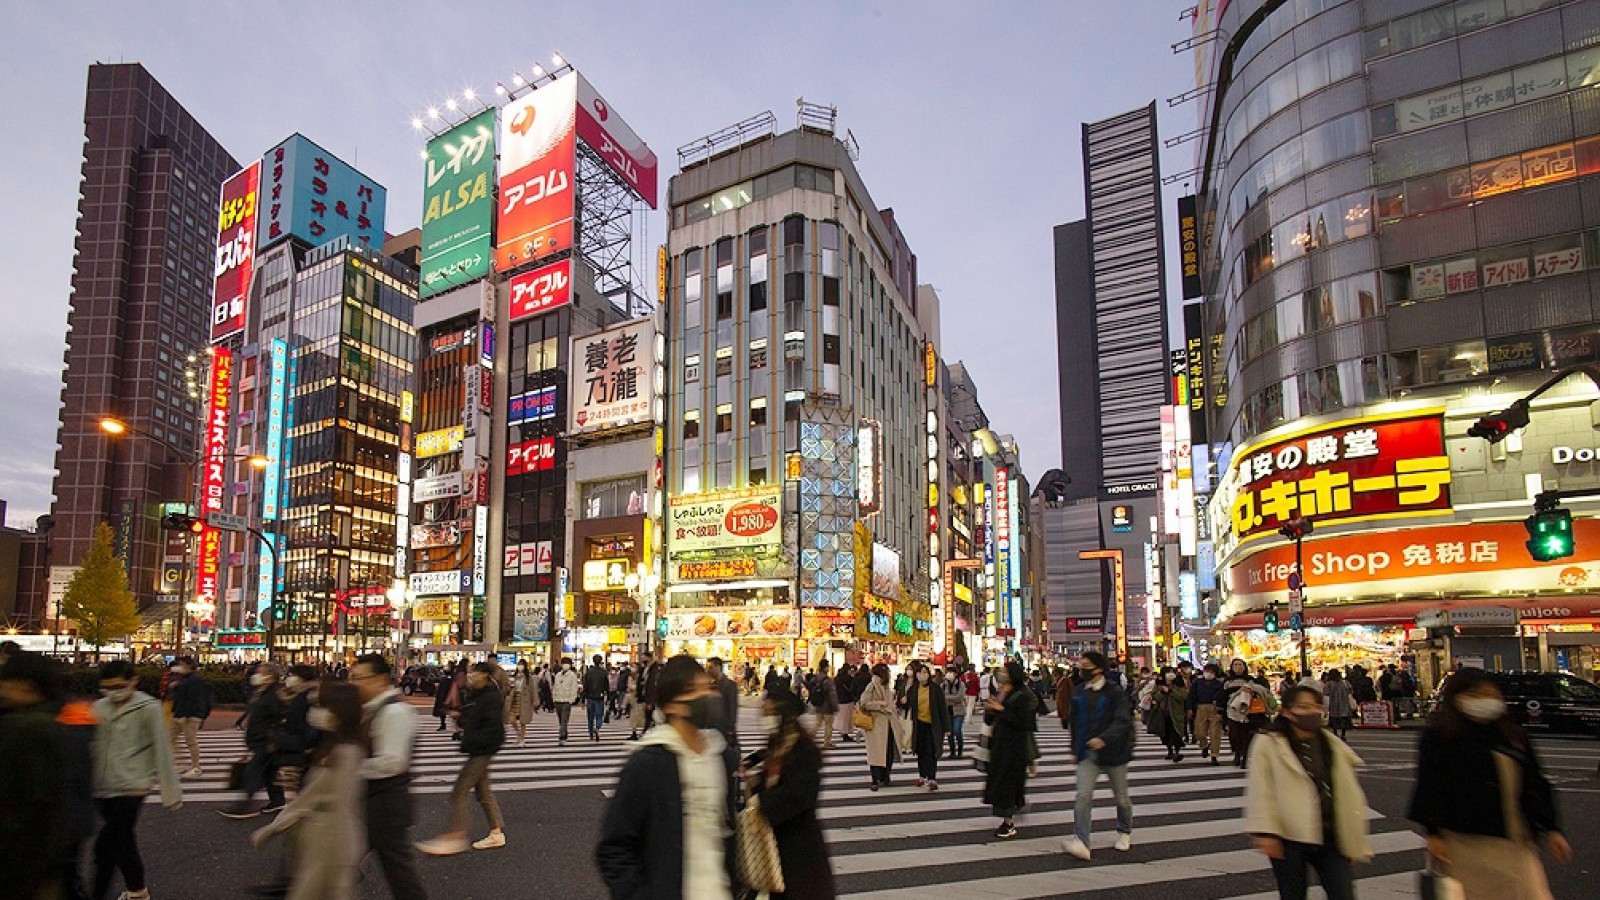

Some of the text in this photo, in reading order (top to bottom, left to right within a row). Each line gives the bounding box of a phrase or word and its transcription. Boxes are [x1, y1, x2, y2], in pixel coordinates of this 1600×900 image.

[427, 125, 491, 188] レイク
[600, 131, 638, 184] アコム
[424, 172, 487, 224] ALSA
[503, 169, 568, 215] アコム
[220, 191, 255, 231] パチンコ
[215, 227, 252, 277] エスパス
[512, 271, 568, 304] アイフル
[1447, 251, 1580, 291] 新宿 アイドル ステージ
[215, 356, 230, 408] パチンコ
[512, 392, 555, 412] PROMISE
[208, 409, 226, 481] エスパス
[510, 442, 555, 465] アイフル
[1107, 485, 1131, 494] HOTEL
[673, 504, 724, 520] しゃぶしゃぶ
[732, 513, 764, 532] 1,980
[675, 524, 723, 540] 食べ放題!
[203, 531, 219, 574] パチンコ
[506, 546, 553, 567] アコム
[1311, 551, 1390, 576] Shop
[1403, 541, 1499, 567] 免税店
[463, 576, 471, 586] 3
